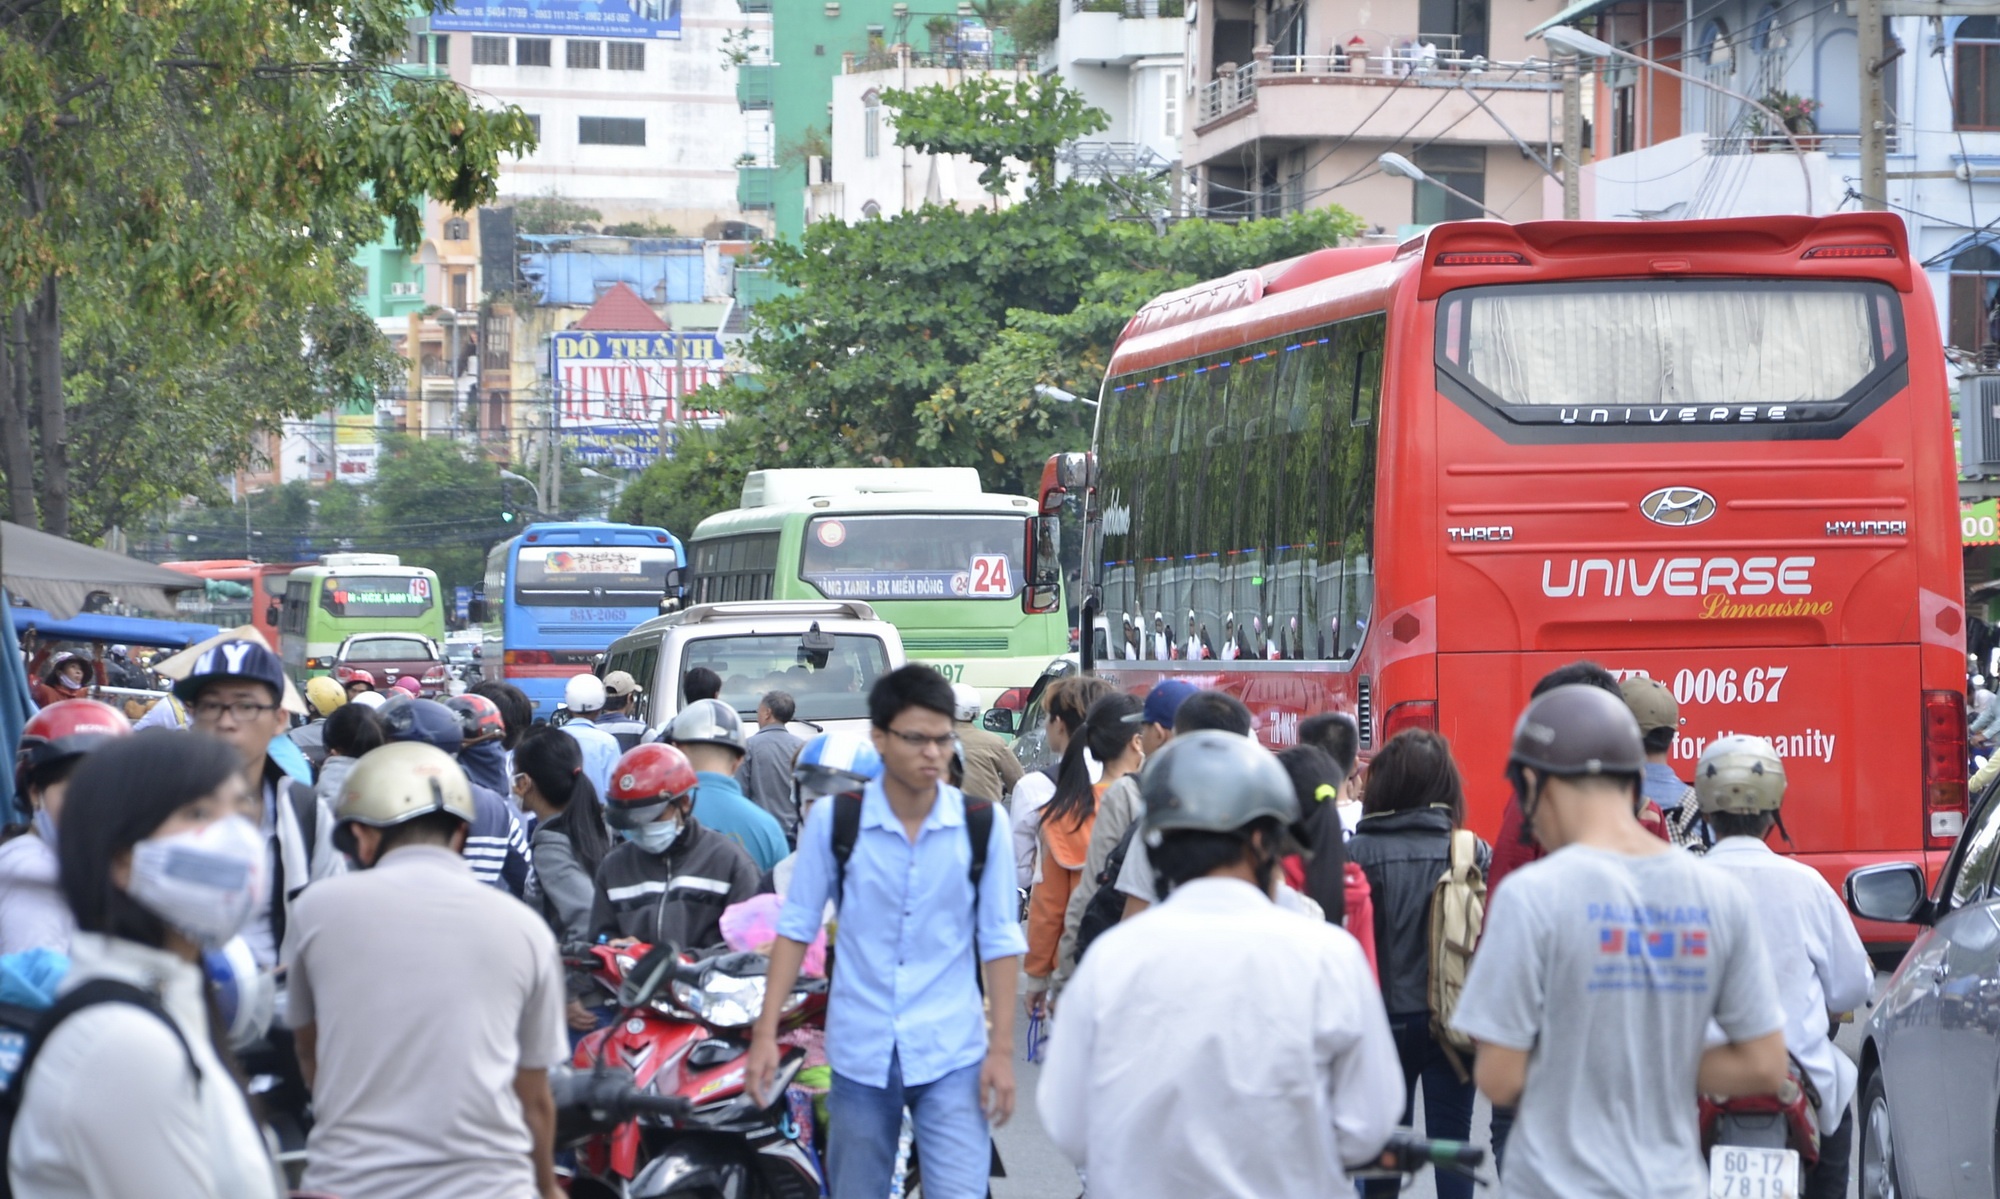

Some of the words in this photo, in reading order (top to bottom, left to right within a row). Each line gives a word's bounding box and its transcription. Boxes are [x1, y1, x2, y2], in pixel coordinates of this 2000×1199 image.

[556, 332, 600, 358] ĐÔ
[606, 332, 715, 359] THÀNH
[1559, 405, 1788, 425] UNIVERSE
[1447, 526, 1514, 542] THACO
[1825, 521, 1907, 536] HYUNDAI
[843, 580, 870, 595] XANH
[916, 576, 944, 594] ĐÔNG
[974, 558, 1006, 592] 24
[1542, 556, 1816, 597] UNIVERSE
[412, 580, 427, 597] 19
[1698, 593, 1834, 620] Limousine
[1672, 731, 1706, 760] for
[1723, 1176, 1785, 1199] 7819
